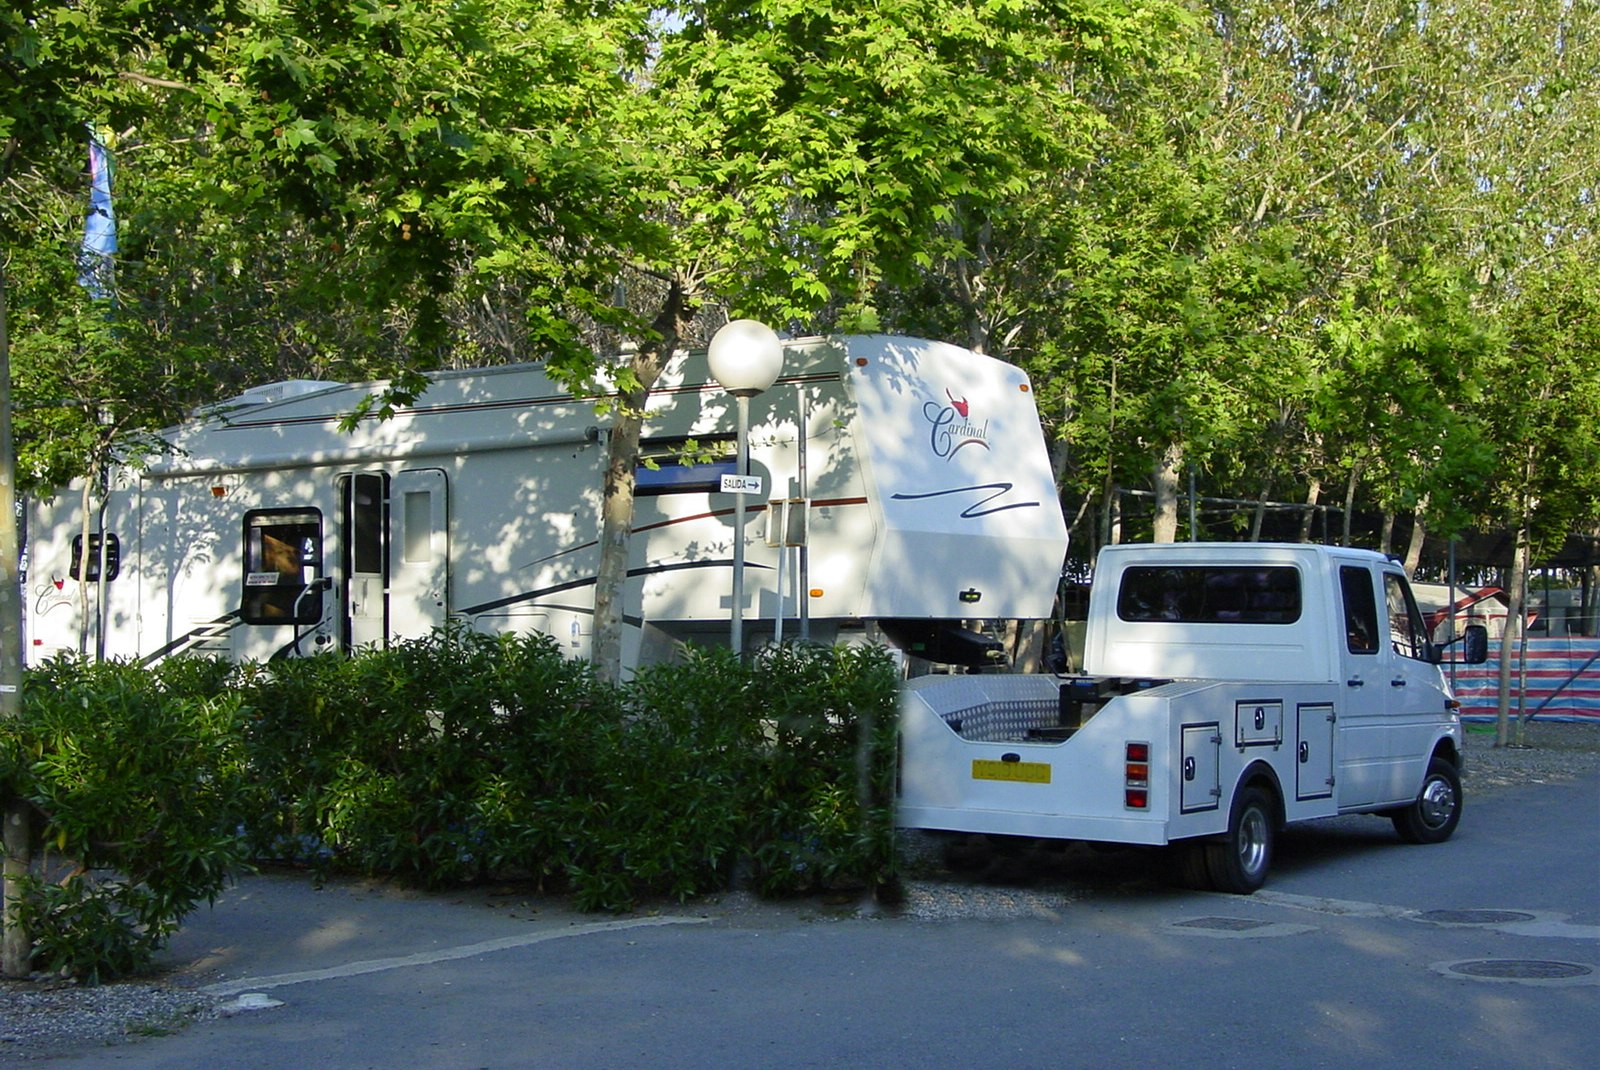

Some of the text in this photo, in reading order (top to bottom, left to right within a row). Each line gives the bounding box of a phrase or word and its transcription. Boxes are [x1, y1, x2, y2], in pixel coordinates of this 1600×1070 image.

[923, 401, 988, 457] Cardinal
[723, 479, 747, 489] SALIDA
[35, 584, 76, 615] Caal
